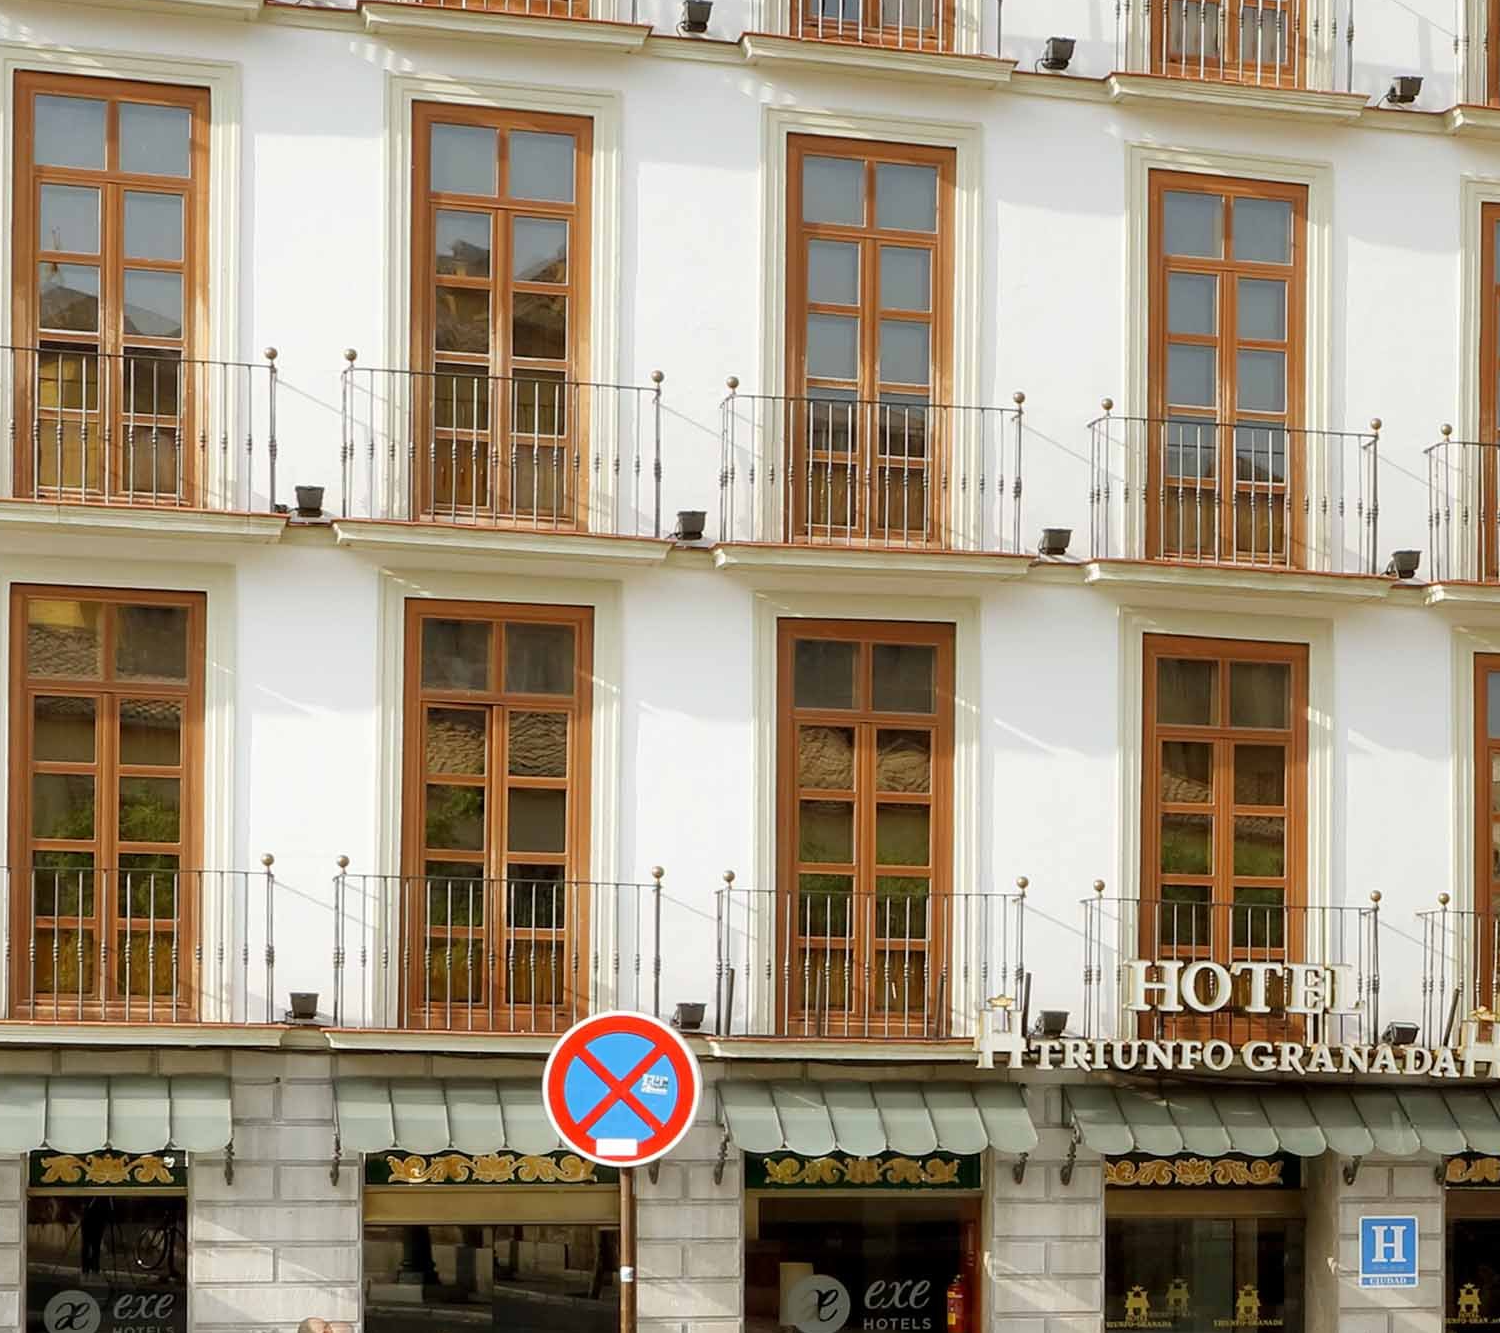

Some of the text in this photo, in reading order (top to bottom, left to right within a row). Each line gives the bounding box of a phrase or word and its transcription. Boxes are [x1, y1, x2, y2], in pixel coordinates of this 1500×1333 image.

[1125, 960, 1365, 1015] HOTEL
[1033, 1039, 1462, 1079] TRIUNFO GRANADA
[1371, 1225, 1407, 1263] H
[864, 1280, 931, 1309] exe
[1369, 1276, 1406, 1285] CIUDAD
[112, 1293, 175, 1320] exe
[863, 1317, 932, 1331] HOTELS
